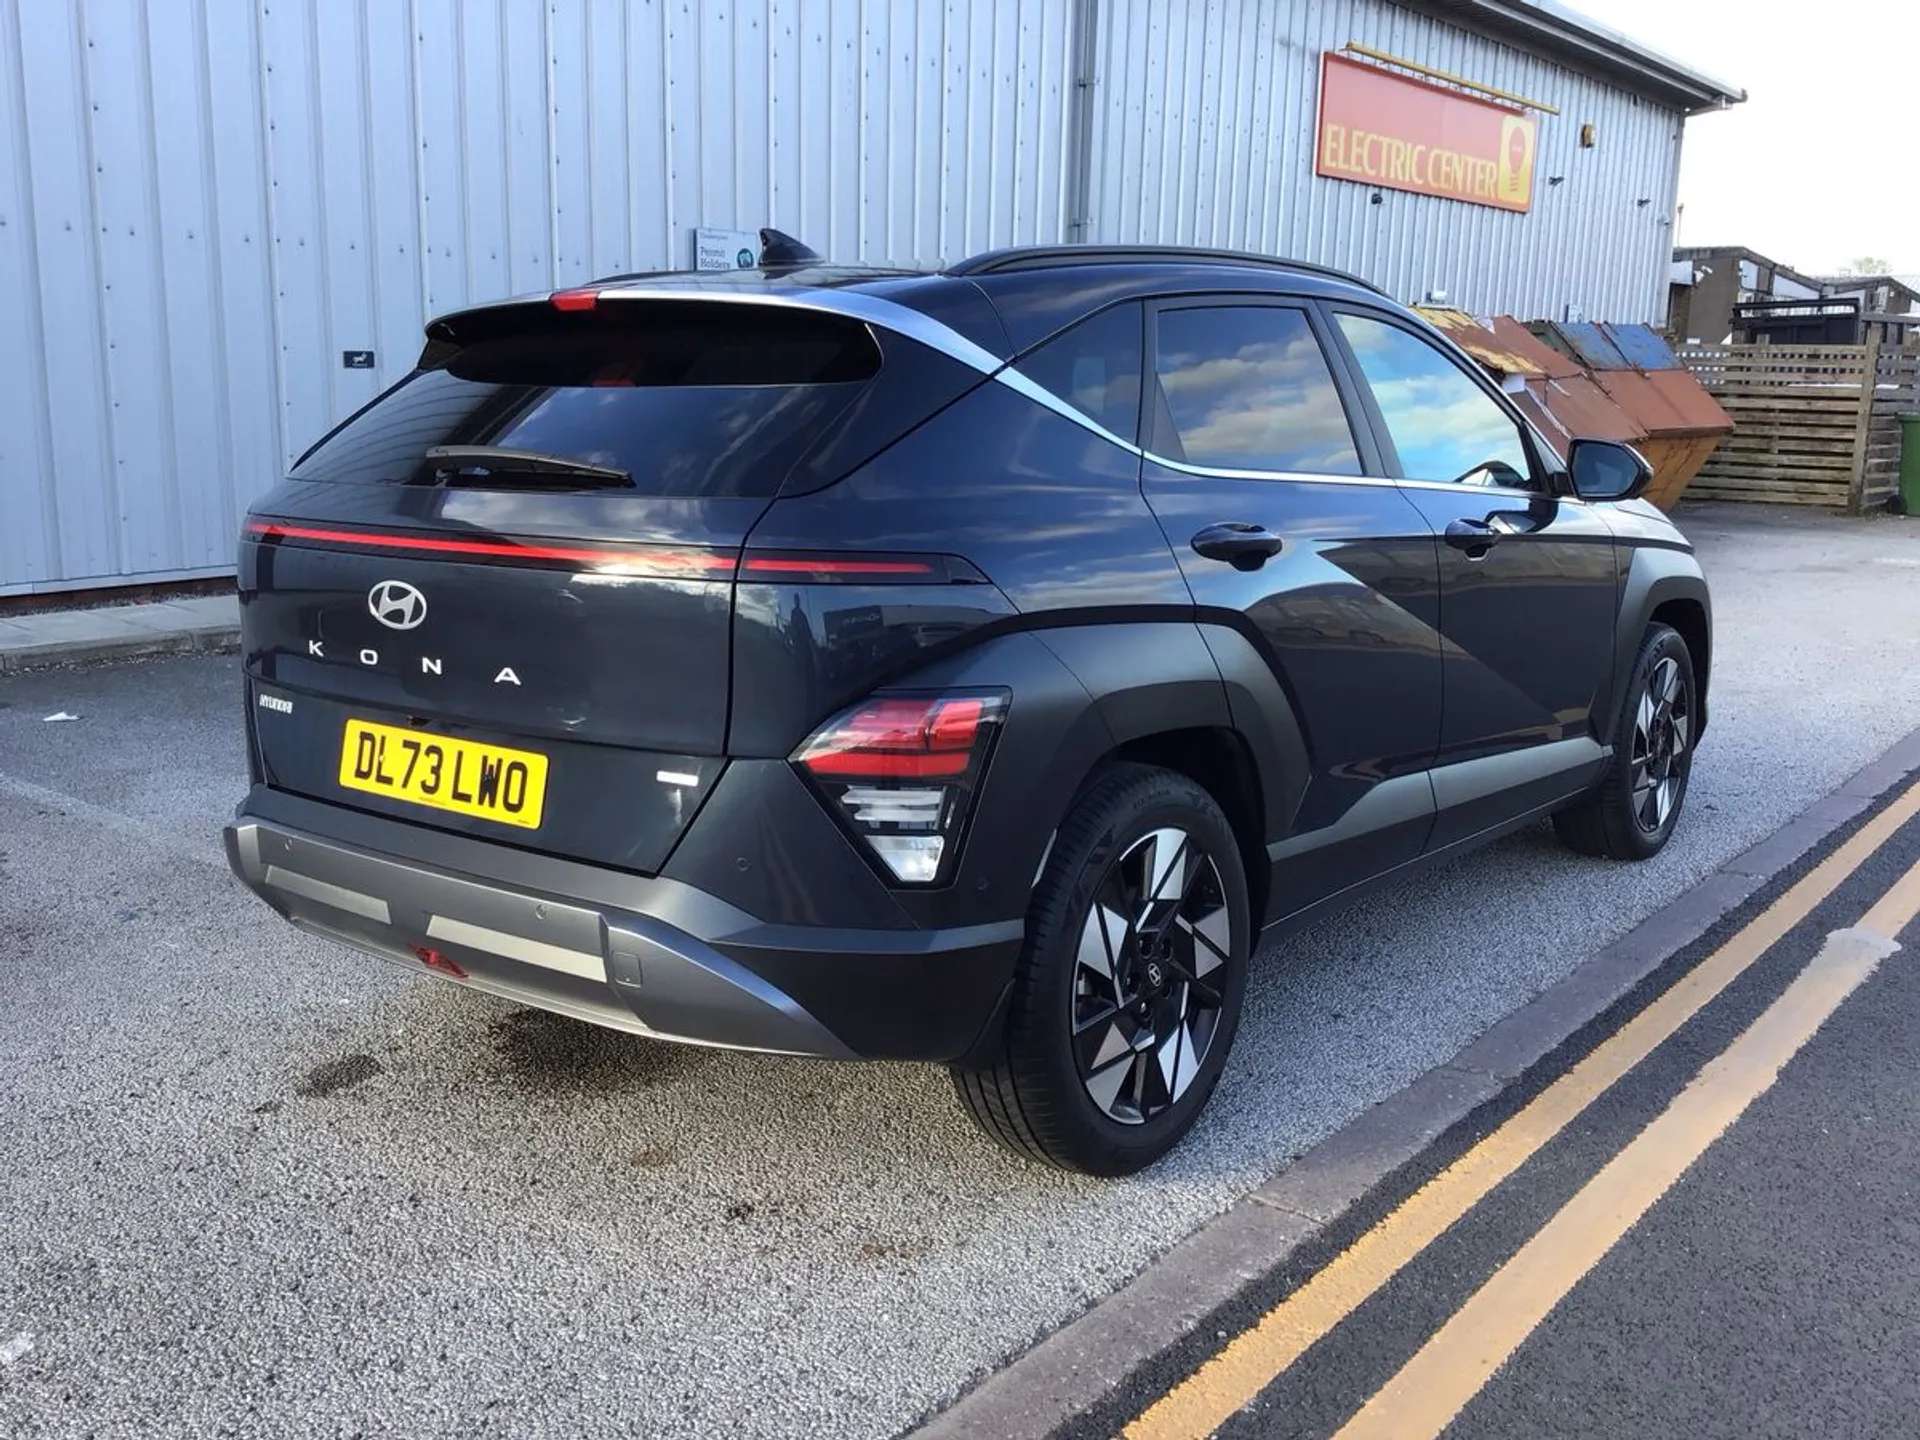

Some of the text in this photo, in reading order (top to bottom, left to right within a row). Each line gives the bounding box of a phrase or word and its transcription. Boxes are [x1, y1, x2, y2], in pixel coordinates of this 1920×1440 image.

[1324, 123, 1498, 198] ELECTRIC CENTER
[308, 639, 522, 686] KONA
[354, 731, 528, 813] DL73 LWO
